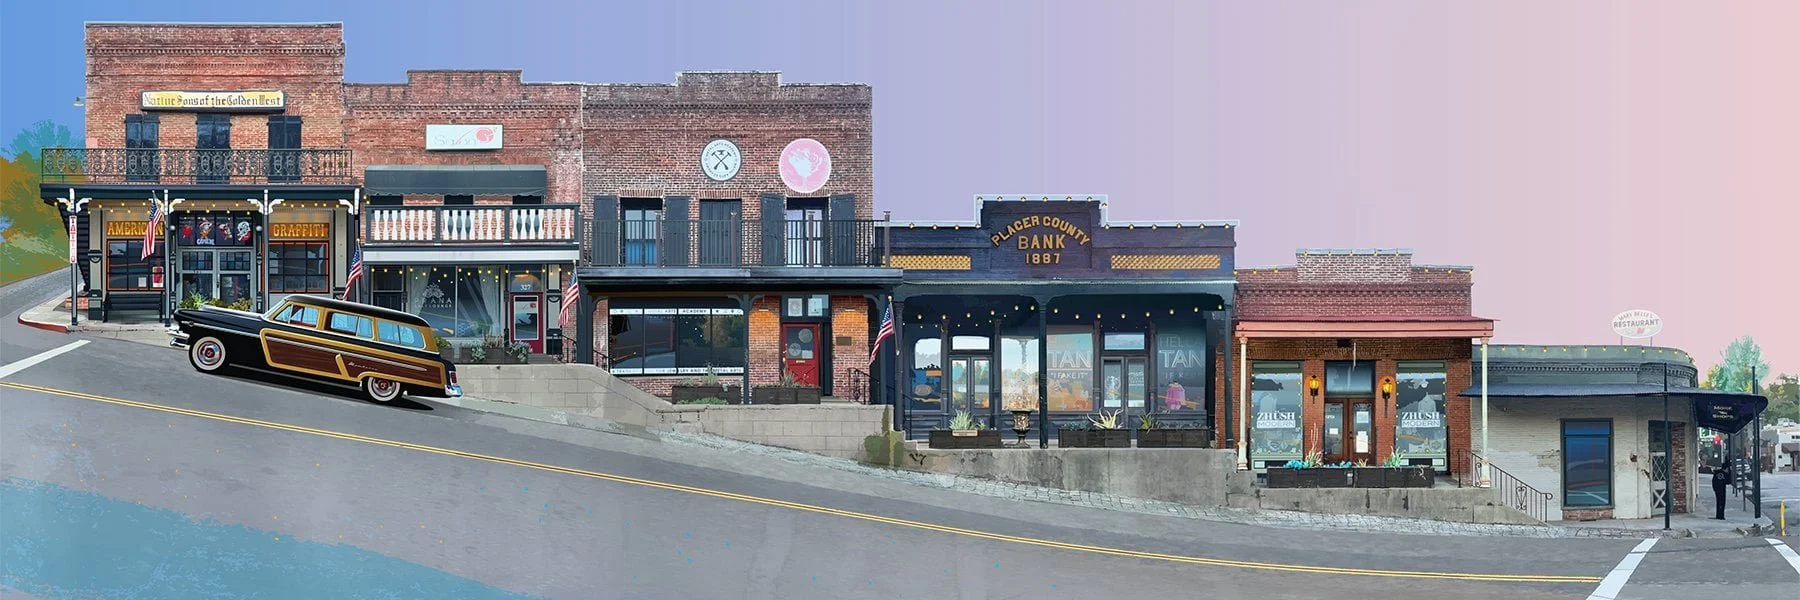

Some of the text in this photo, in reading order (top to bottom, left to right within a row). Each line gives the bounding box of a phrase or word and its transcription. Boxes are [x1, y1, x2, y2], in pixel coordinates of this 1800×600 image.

[144, 94, 280, 106] Native Sons of the Golden West
[107, 222, 164, 236] AMERICN
[273, 224, 325, 237] GRAFFITI
[991, 216, 1090, 246] PLACER COUNTY
[1018, 234, 1065, 250] BANK
[1026, 253, 1060, 264] 1887
[1613, 318, 1659, 328] RESTAURANT
[1047, 349, 1093, 368] TAN
[1159, 349, 1202, 368] TAN
